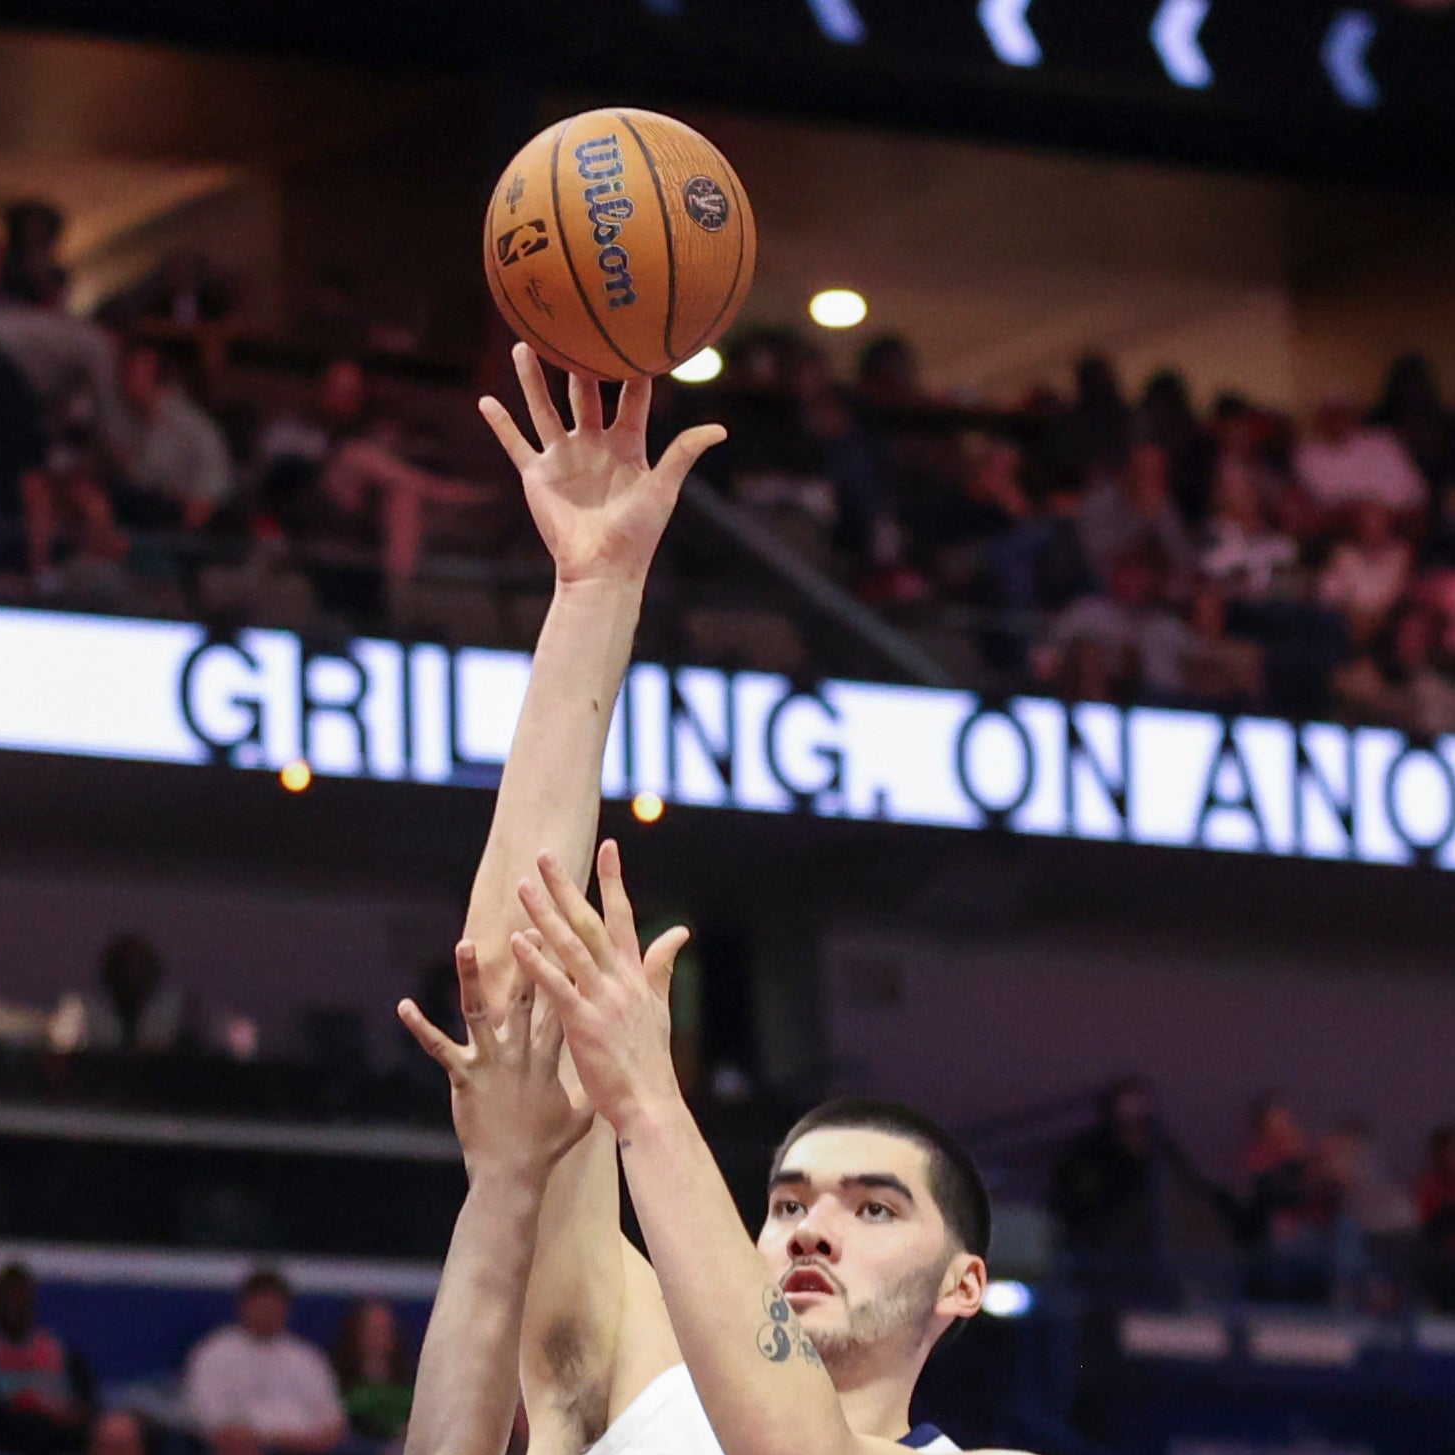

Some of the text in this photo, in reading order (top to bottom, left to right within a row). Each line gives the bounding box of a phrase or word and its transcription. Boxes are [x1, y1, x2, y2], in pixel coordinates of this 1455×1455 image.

[573, 133, 637, 309] Wilson
[181, 634, 891, 822] GRILING.
[955, 702, 1130, 842] ON
